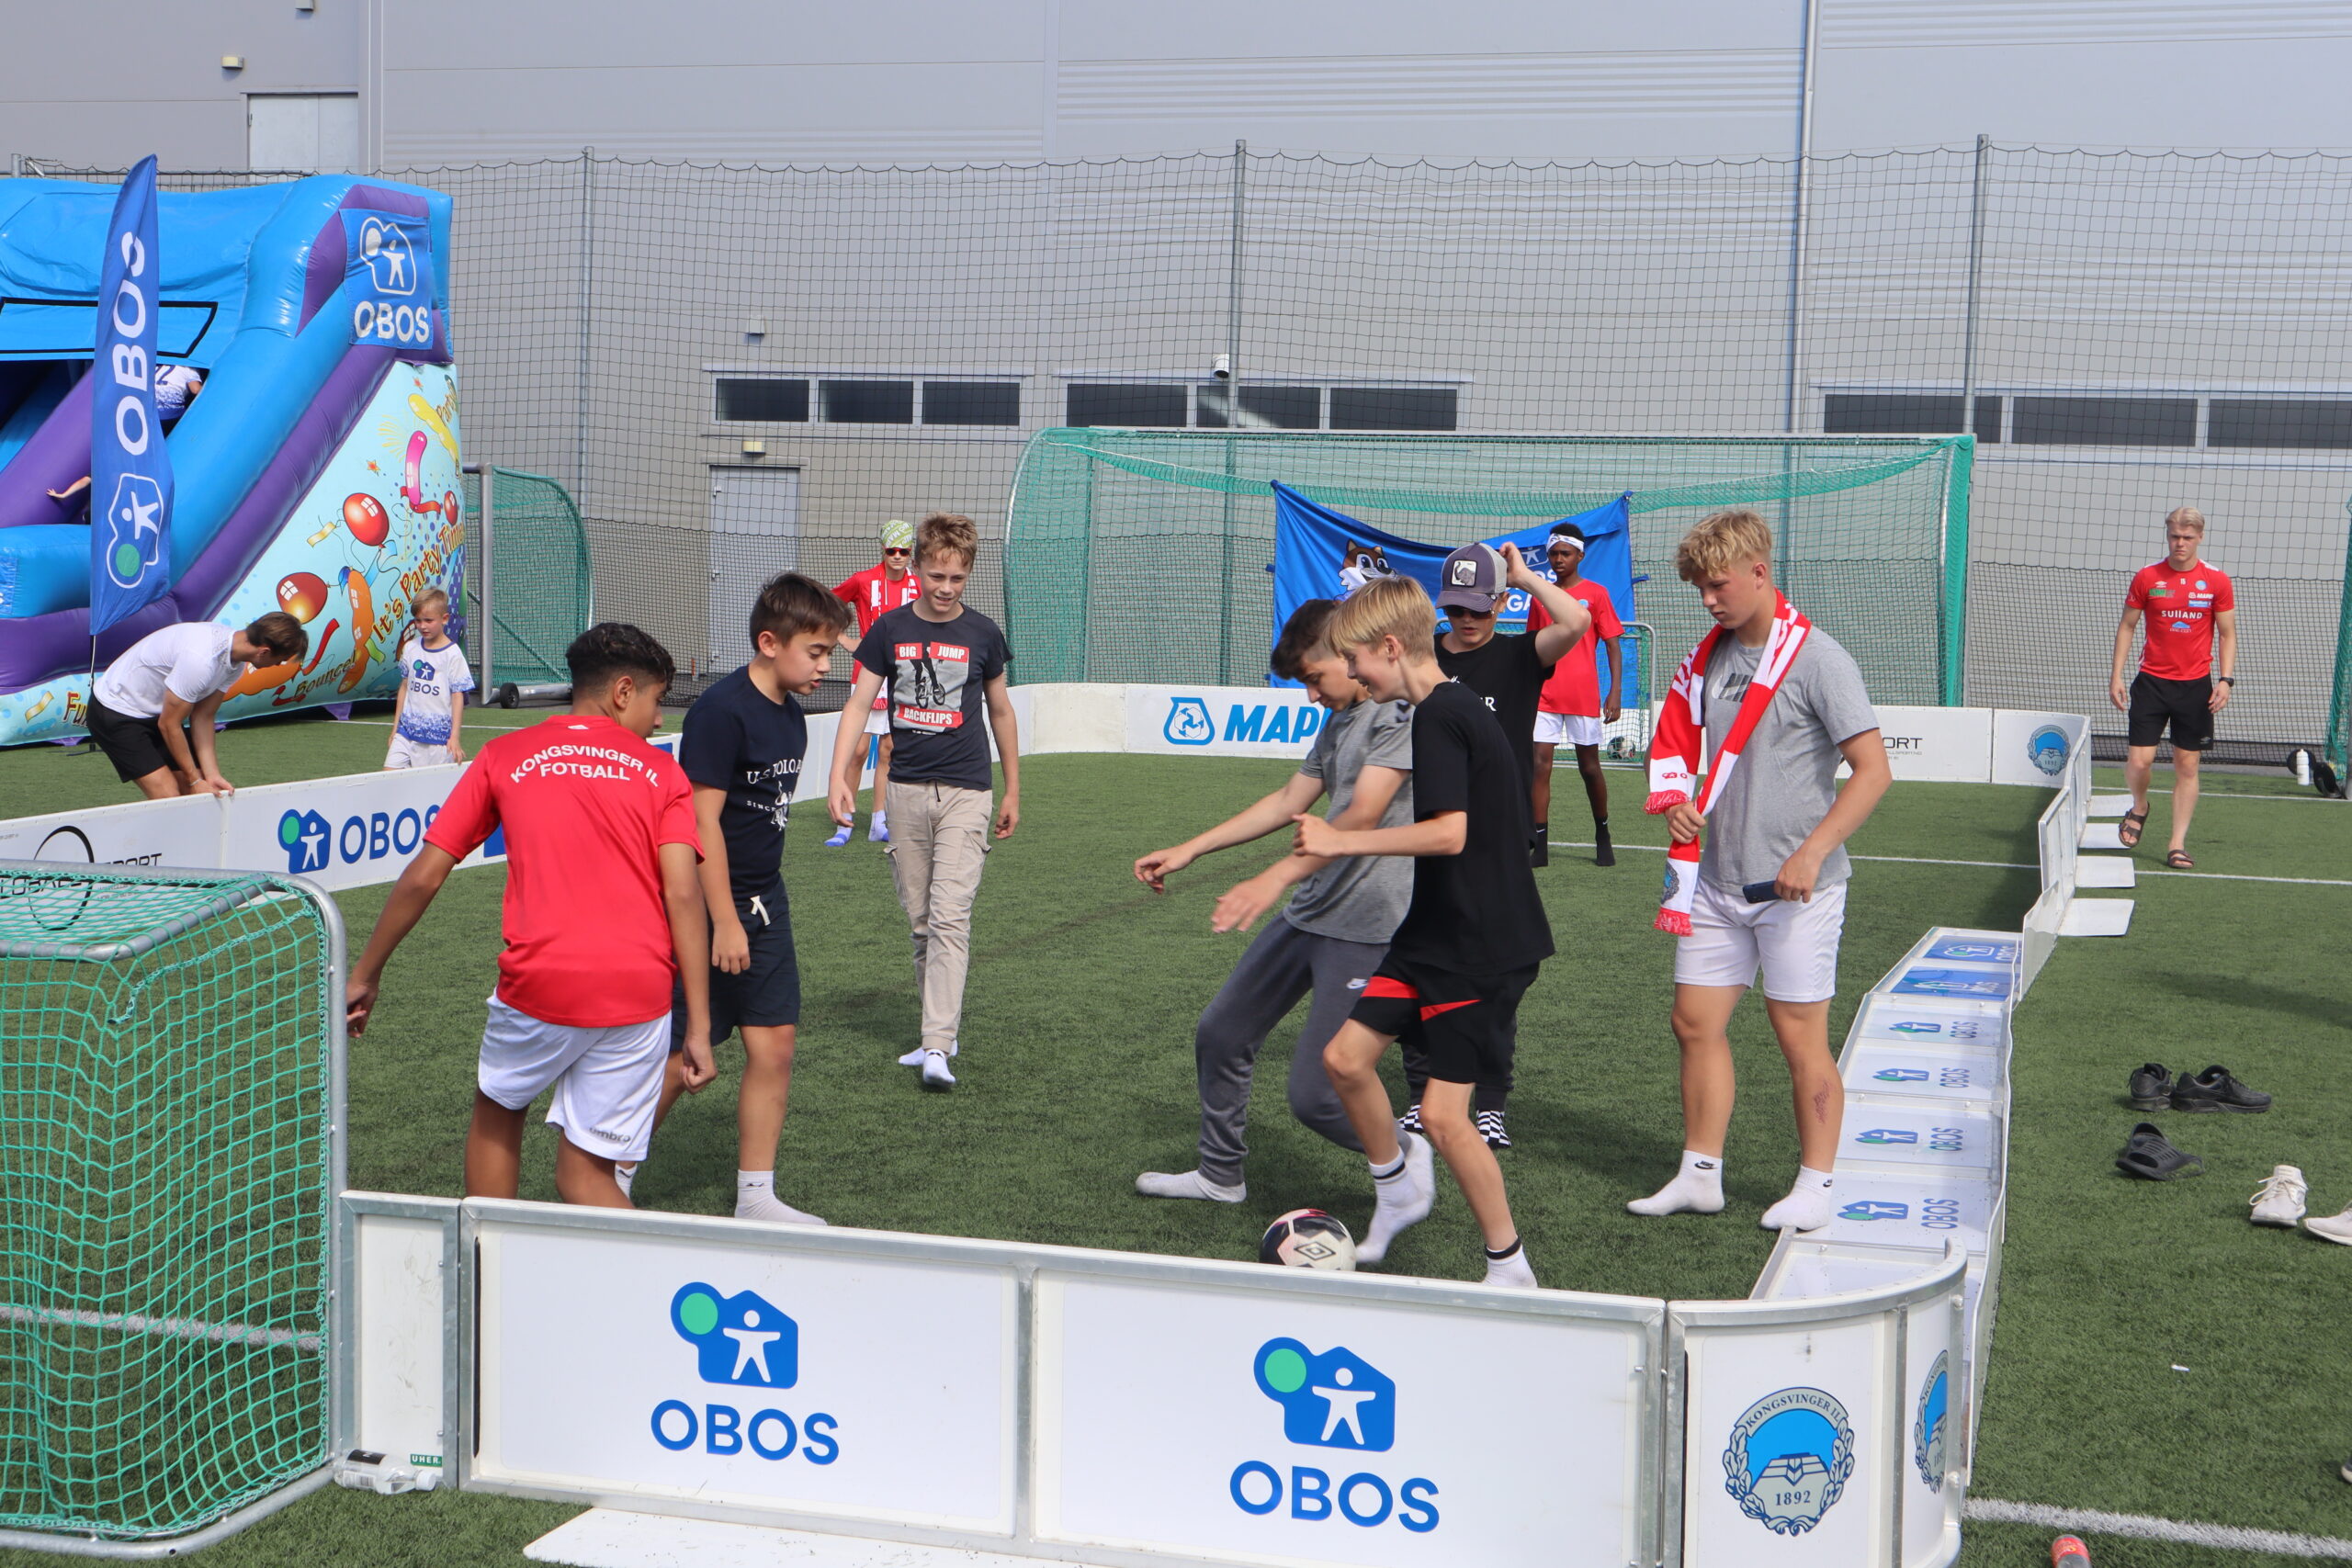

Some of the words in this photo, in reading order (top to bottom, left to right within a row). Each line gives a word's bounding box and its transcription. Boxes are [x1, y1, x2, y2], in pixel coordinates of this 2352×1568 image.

[354, 300, 430, 344] OBOS
[113, 231, 149, 456] OBOS
[400, 542, 442, 605] Party
[899, 646, 917, 658] BIG
[937, 645, 966, 660] JUMP
[903, 706, 953, 726] BACKFLIPS
[1882, 737, 1923, 750] ORT
[510, 744, 644, 784] KONGSVINGER
[645, 768, 659, 787] IL
[539, 761, 631, 782] FOTBALL
[1950, 1021, 1979, 1039] OBOS
[1939, 1067, 1971, 1089] OBOS
[589, 1127, 631, 1142] umbro
[1929, 1127, 1963, 1152] OBOS
[1920, 1198, 1960, 1229] OBOS
[1747, 1393, 1831, 1428] KONGSVINGER
[1832, 1408, 1842, 1423] IL
[650, 1399, 840, 1465] OBOS
[1229, 1460, 1441, 1533] OBOS
[1775, 1490, 1811, 1506] 1892
